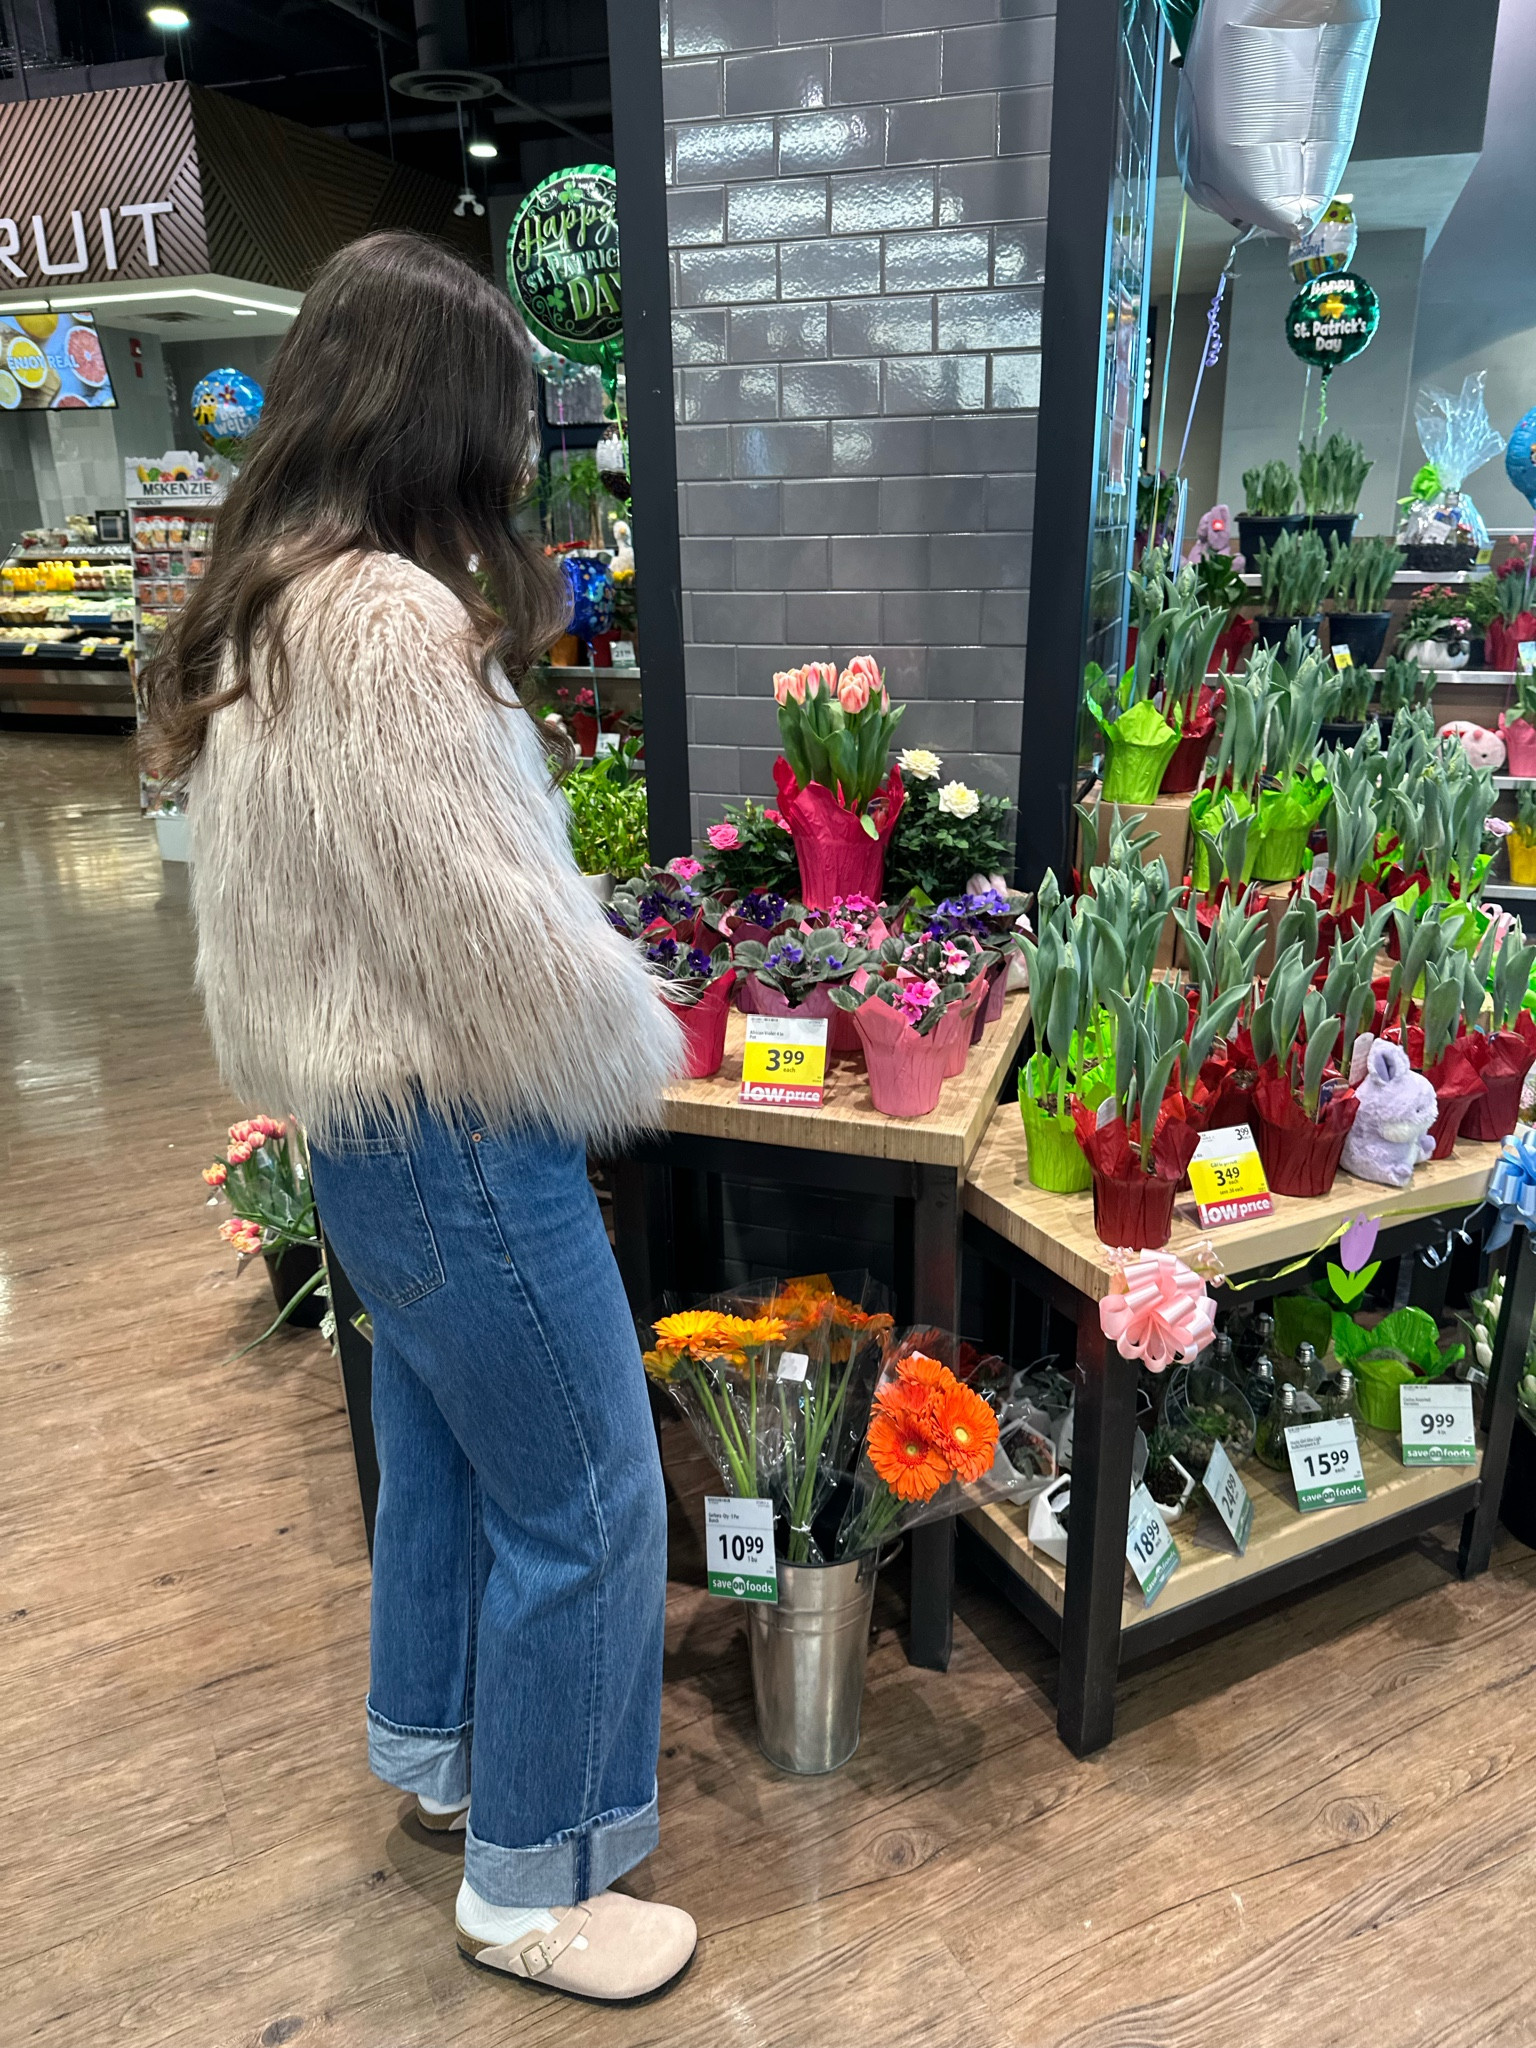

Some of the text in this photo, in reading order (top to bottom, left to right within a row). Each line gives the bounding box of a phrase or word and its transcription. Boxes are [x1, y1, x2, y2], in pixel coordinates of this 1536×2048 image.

[516, 203, 617, 272] Happy
[1293, 317, 1367, 338] St. Patrick's
[1315, 336, 1342, 352] Day
[8, 354, 80, 370] ENJOY REAL
